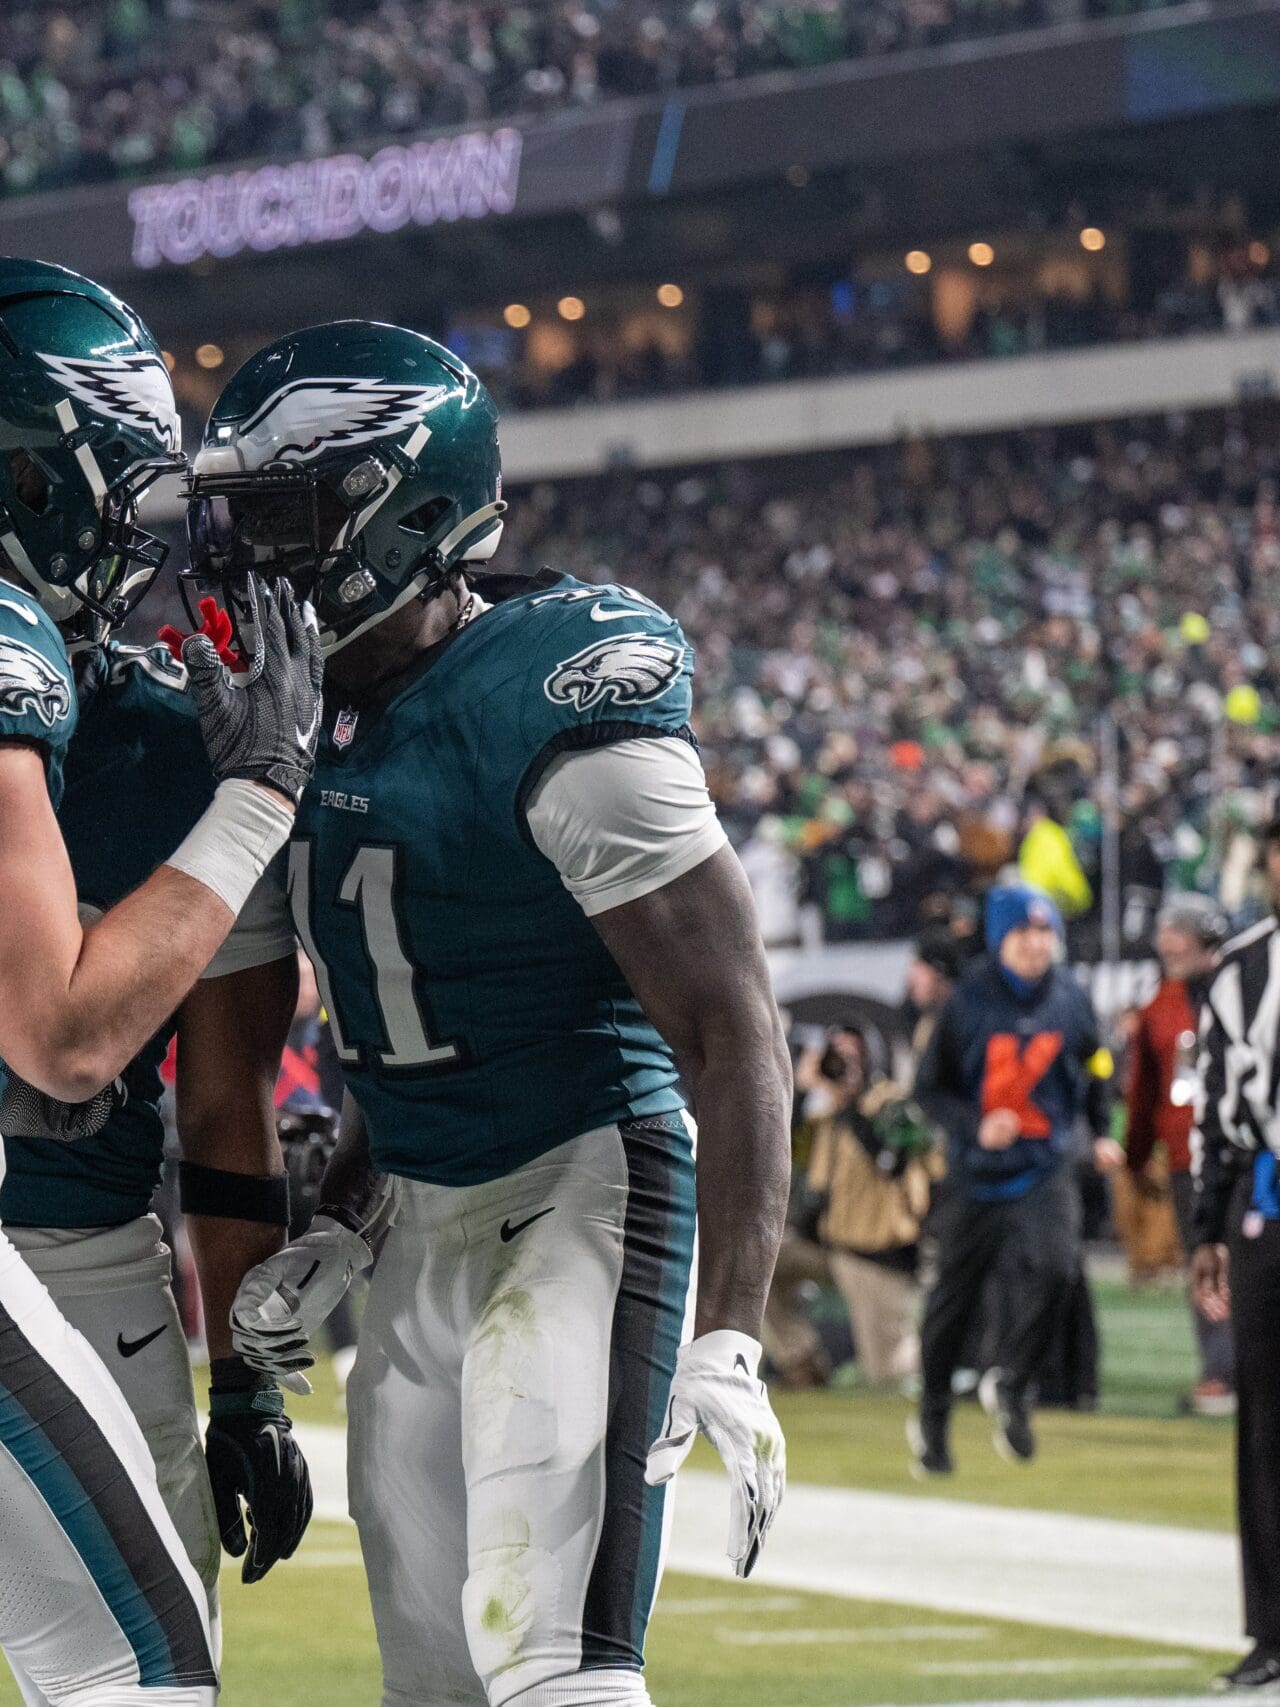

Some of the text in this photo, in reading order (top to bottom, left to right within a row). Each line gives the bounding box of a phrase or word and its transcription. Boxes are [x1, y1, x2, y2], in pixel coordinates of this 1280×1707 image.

[128, 127, 521, 269] TOUCHDOWN
[320, 789, 370, 814] EAGLES
[286, 840, 458, 1067] 11
[982, 1032, 1064, 1139] K
